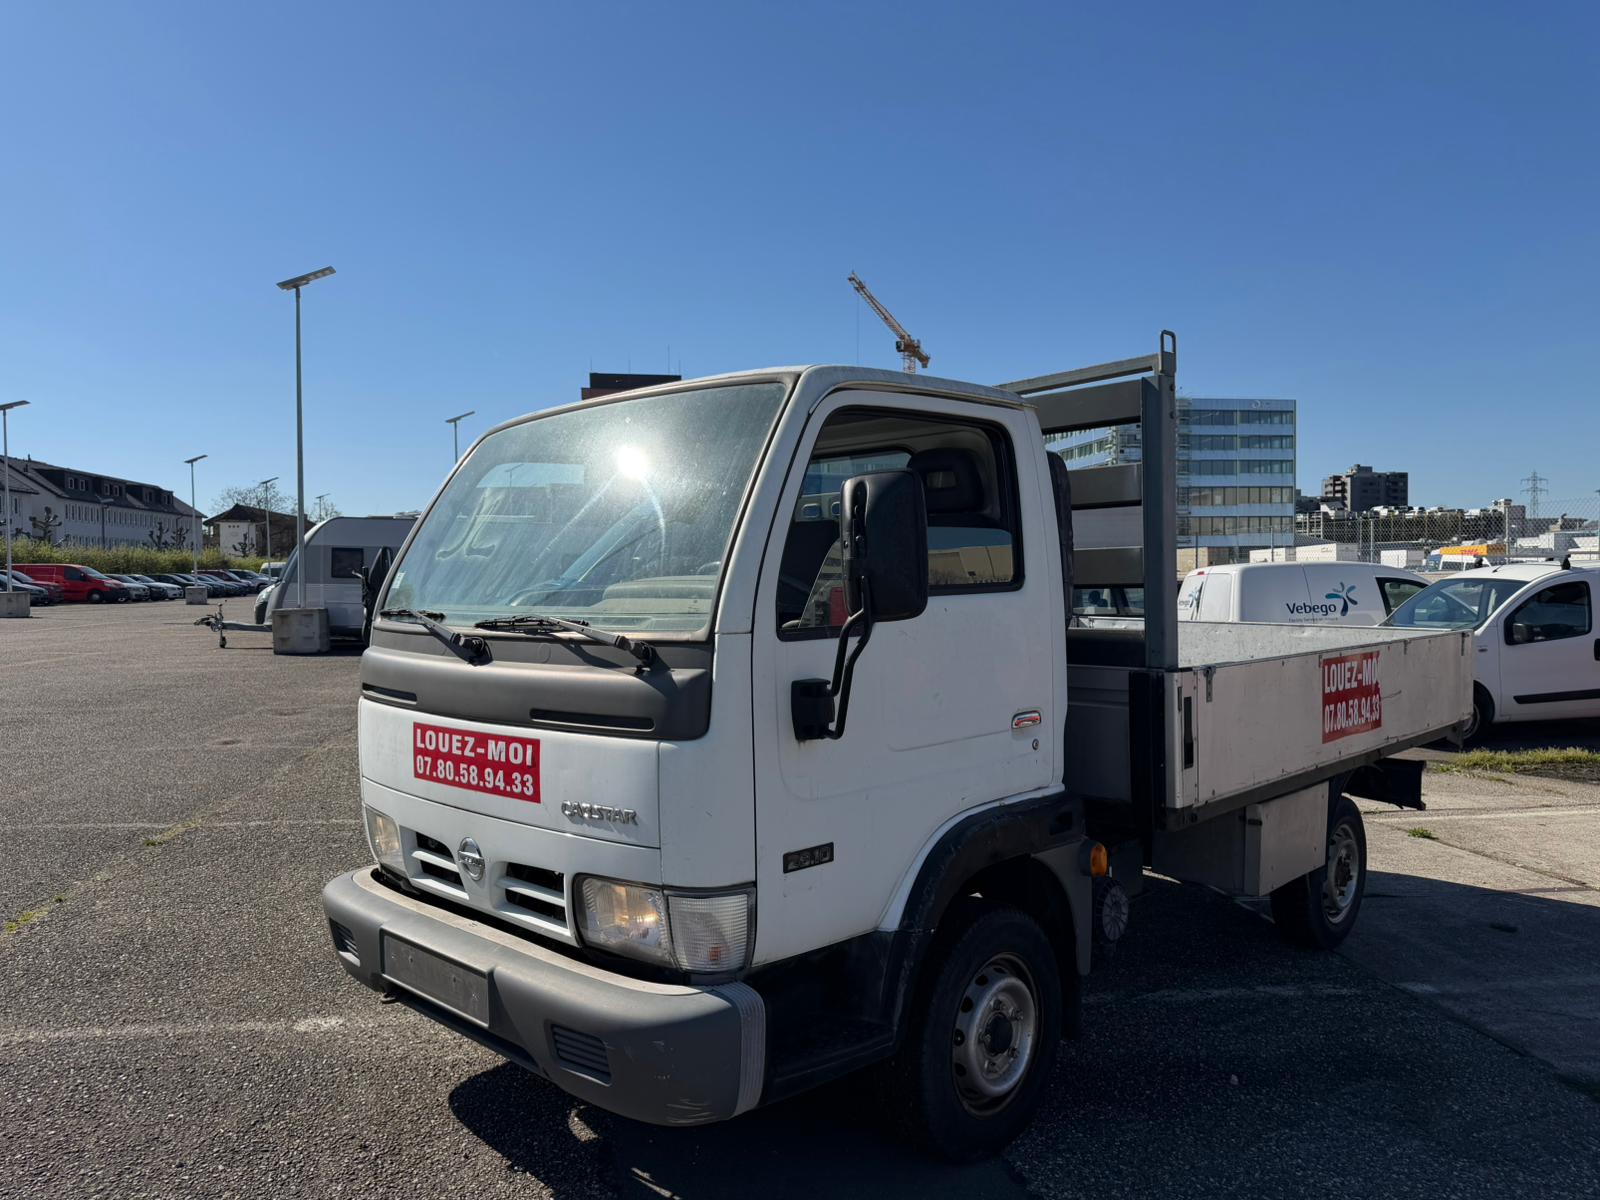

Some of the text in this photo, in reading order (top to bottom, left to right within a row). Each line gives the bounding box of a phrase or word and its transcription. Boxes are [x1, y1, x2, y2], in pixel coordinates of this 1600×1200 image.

[1286, 602, 1337, 617] Vebego
[1324, 658, 1381, 693] LOUEZ-MO
[416, 728, 533, 766] LOUEZ-MOI
[416, 754, 534, 797] 07.80.58.94.33
